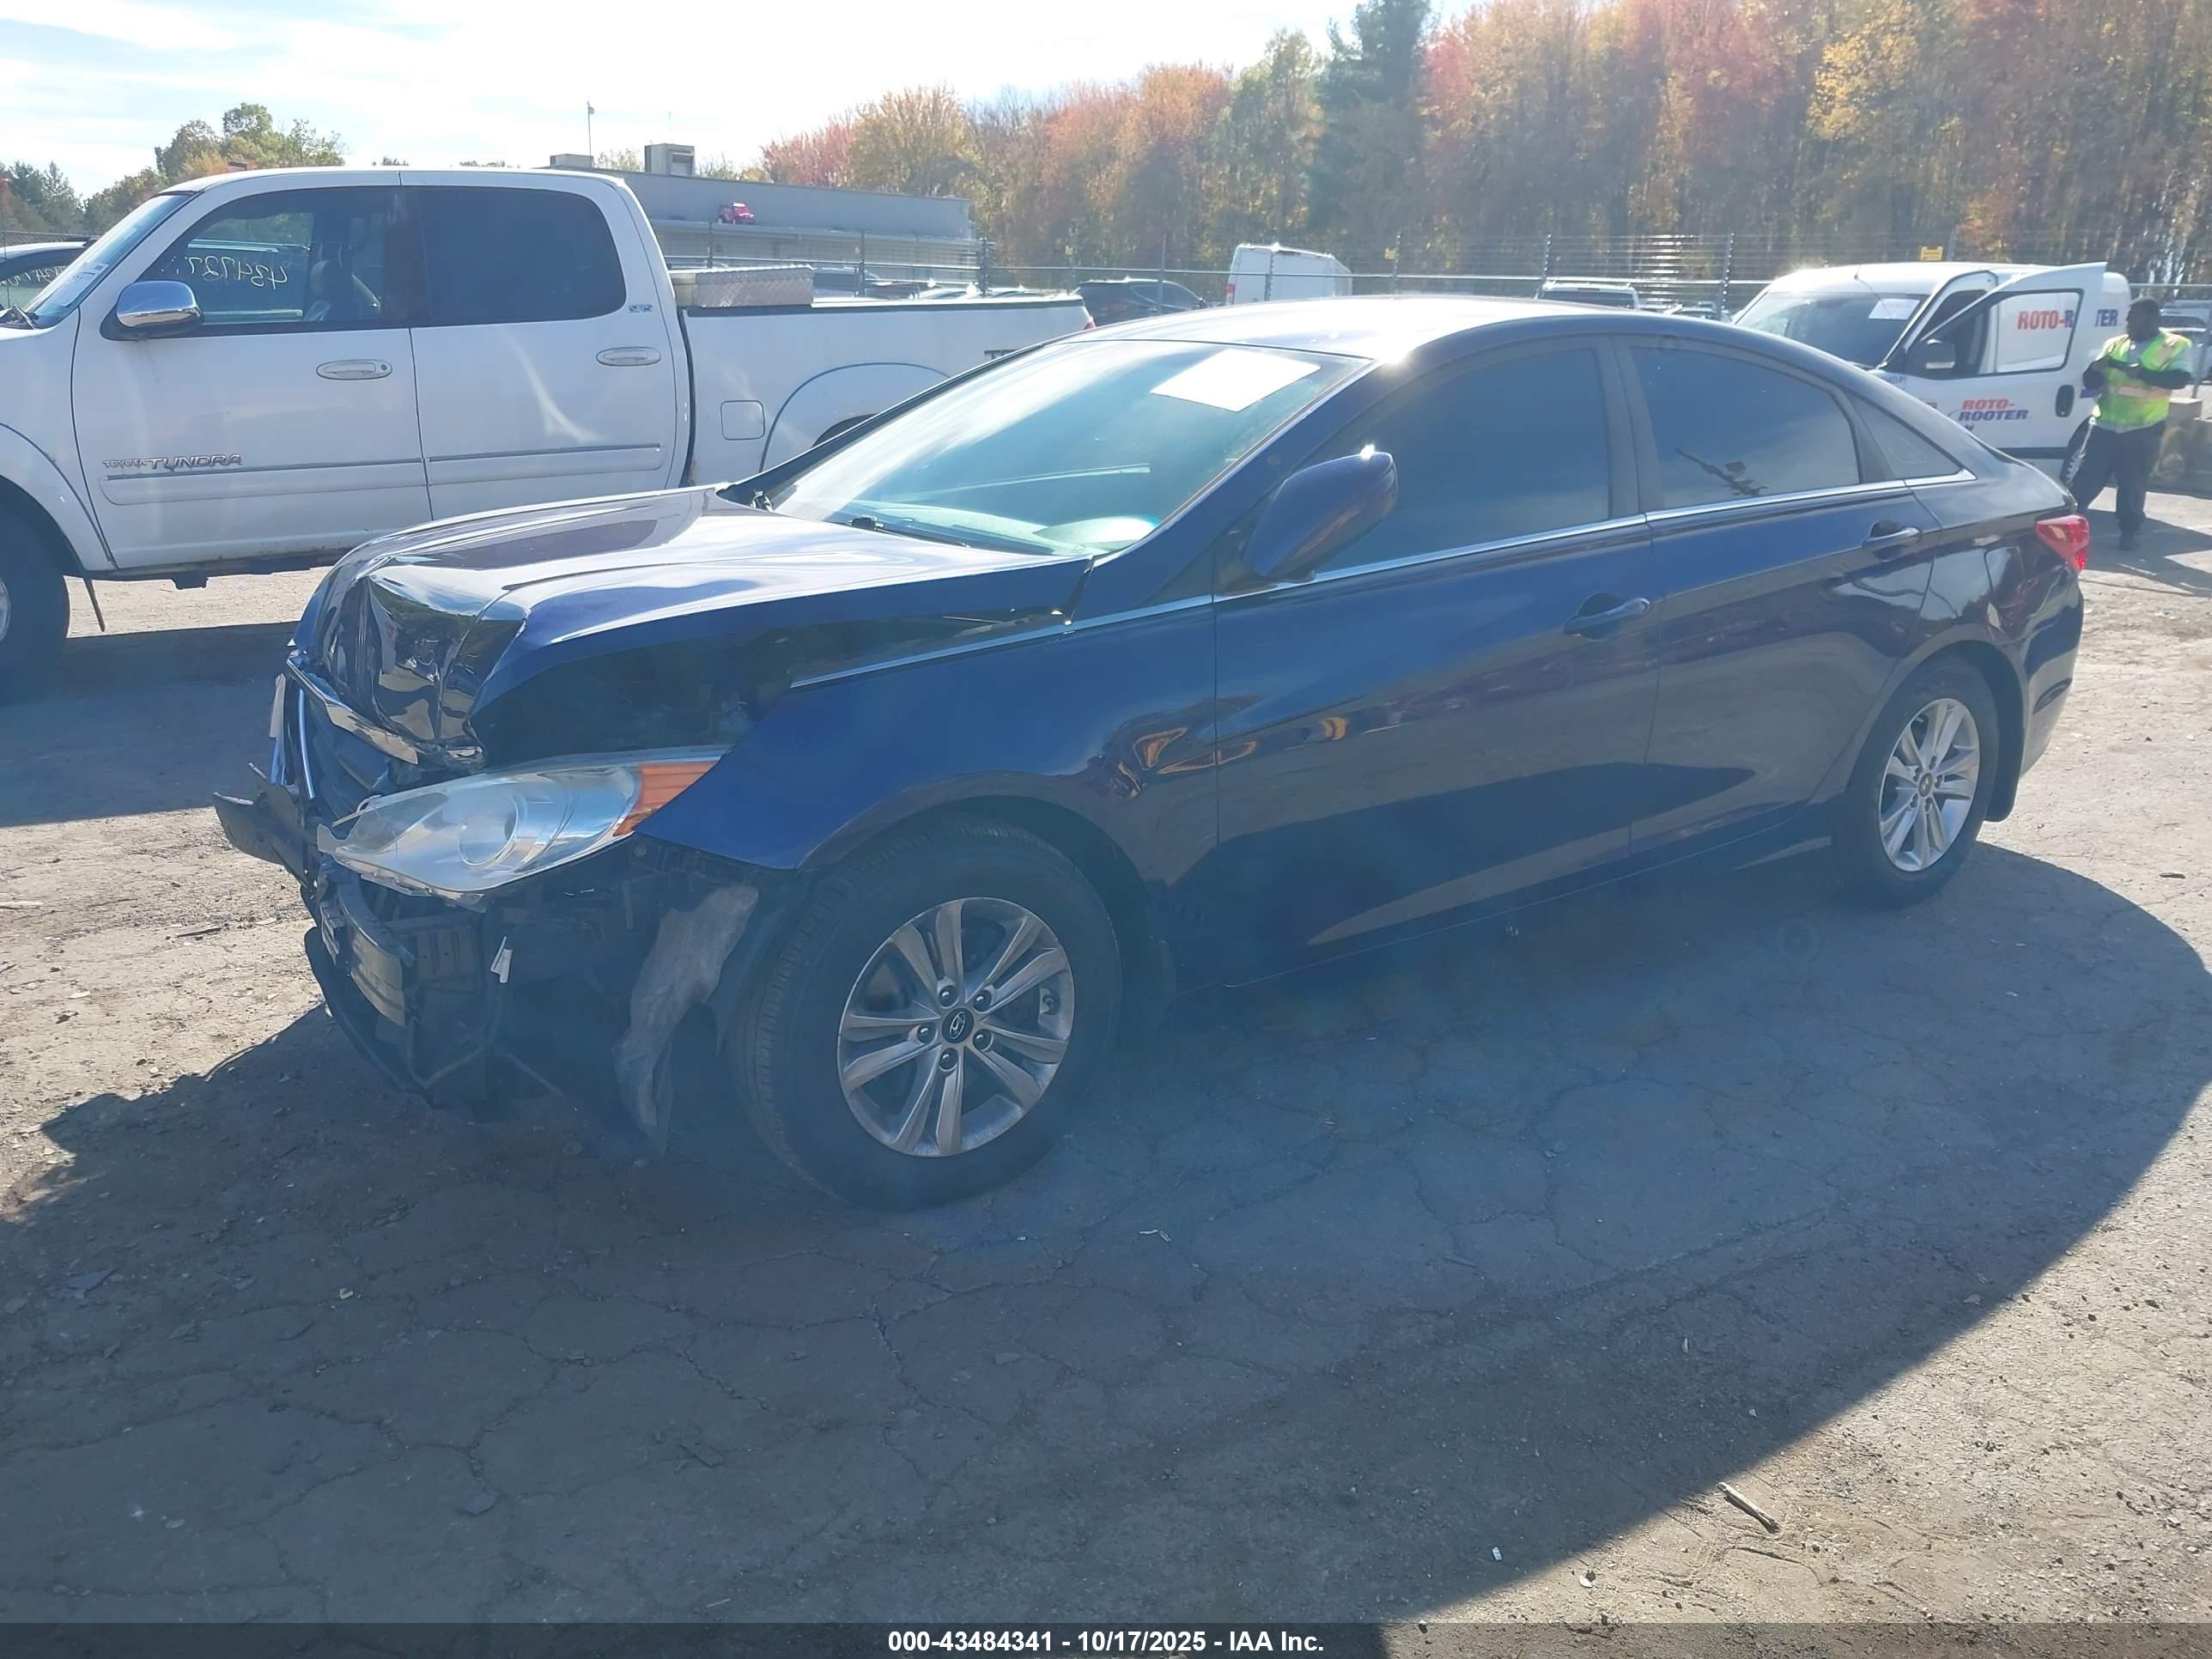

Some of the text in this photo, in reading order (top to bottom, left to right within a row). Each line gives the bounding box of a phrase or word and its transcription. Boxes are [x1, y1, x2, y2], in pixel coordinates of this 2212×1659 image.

[1962, 398, 2015, 410] ROTO-
[1958, 410, 2028, 421] ROOTER
[102, 454, 243, 471] TOYOTA TUNDRA
